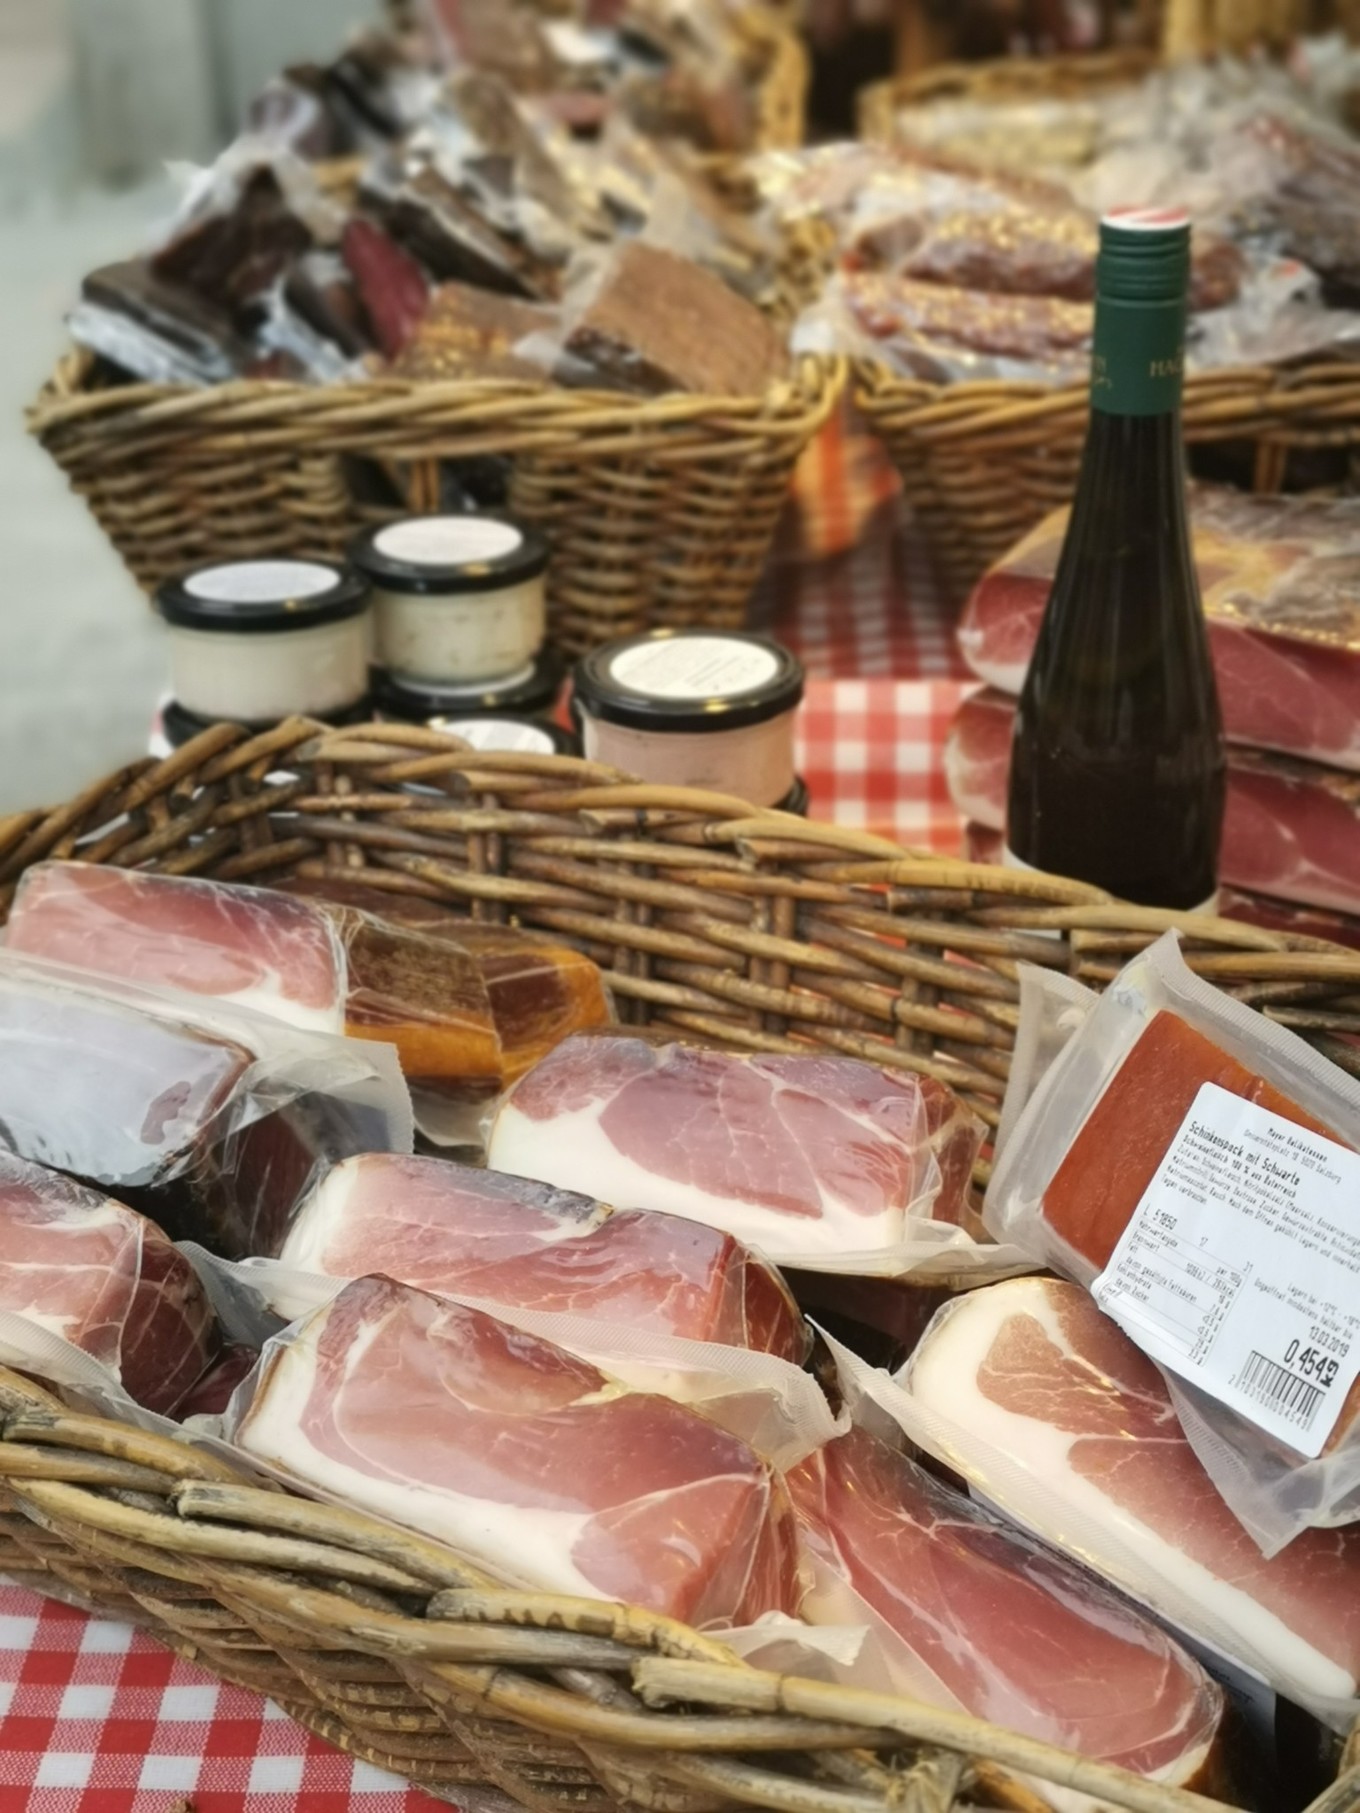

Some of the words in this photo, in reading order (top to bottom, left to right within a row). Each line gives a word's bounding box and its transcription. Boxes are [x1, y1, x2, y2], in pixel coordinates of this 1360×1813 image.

[1245, 1153, 1261, 1165] mit
[1262, 1158, 1300, 1185] Schwarte
[1284, 1339, 1328, 1380] 0,454
